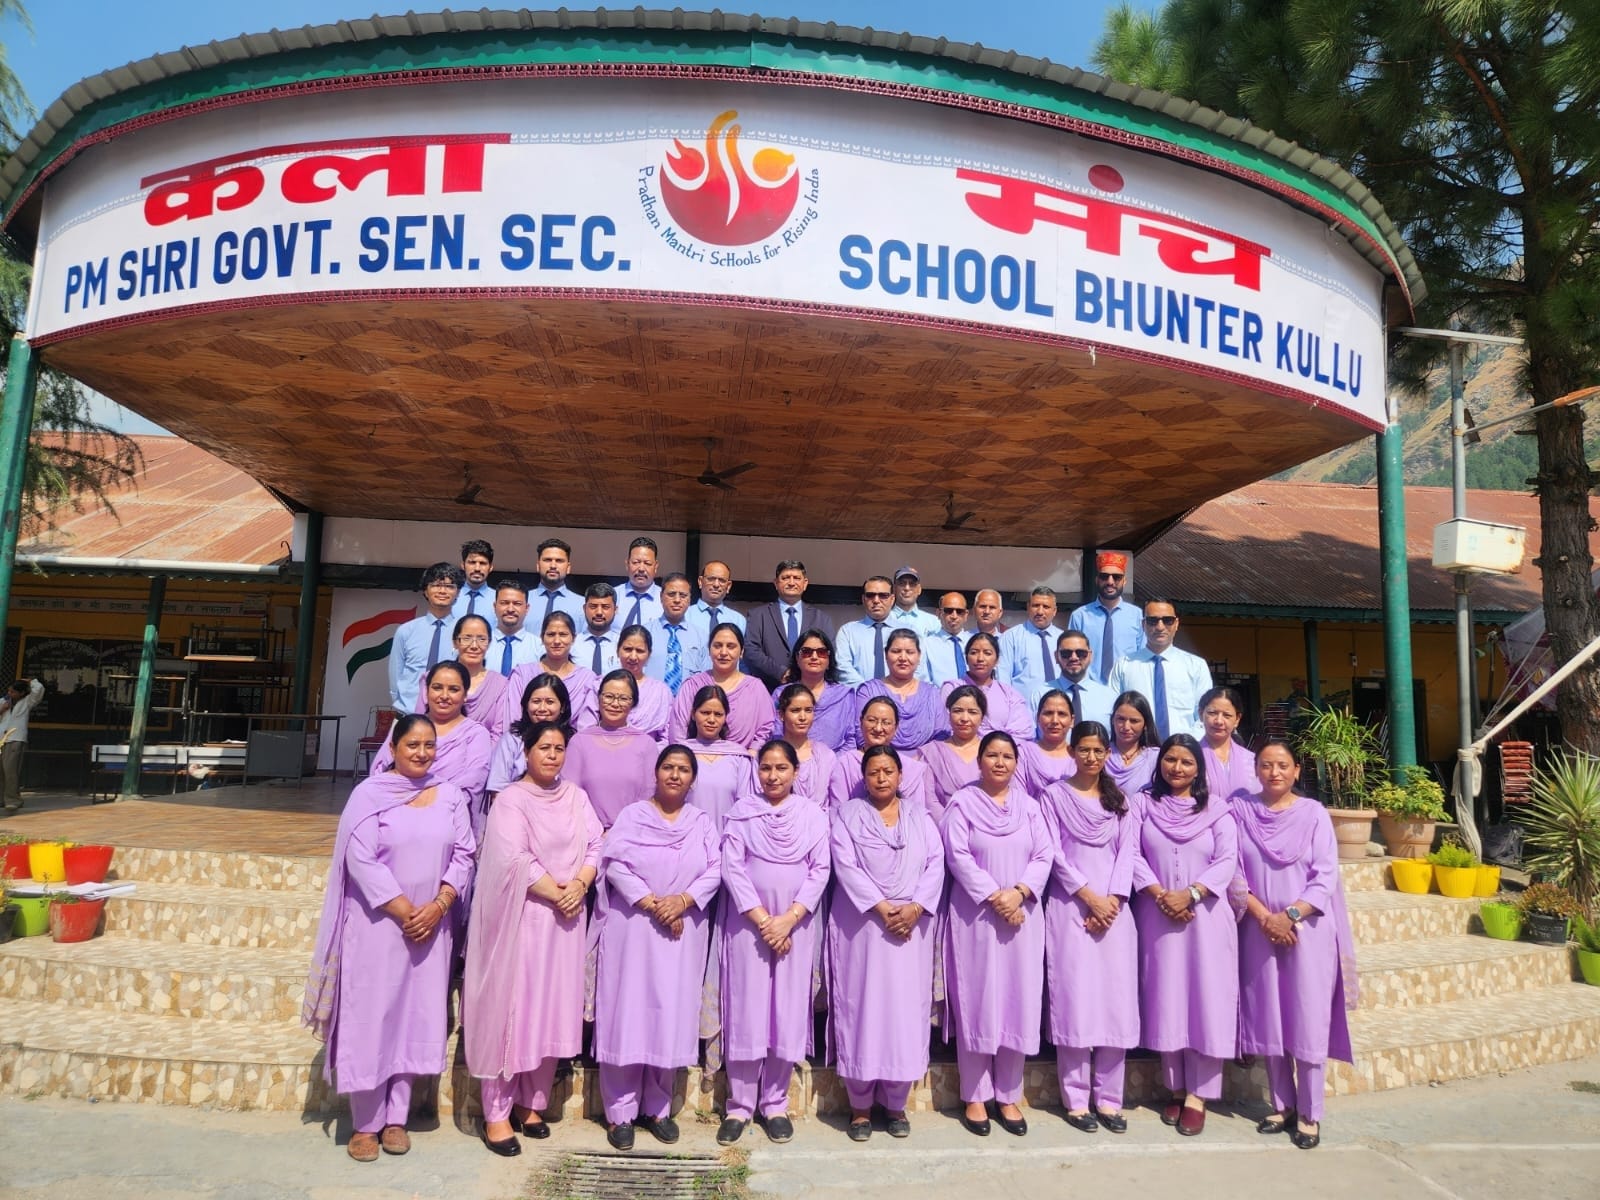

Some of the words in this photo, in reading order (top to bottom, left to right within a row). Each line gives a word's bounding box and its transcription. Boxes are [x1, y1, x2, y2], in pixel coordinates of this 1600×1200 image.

[140, 133, 511, 227] कला
[956, 164, 1272, 292] मंच
[638, 165, 661, 229] Pradhan
[660, 226, 705, 263] Mantri
[763, 244, 782, 260] for
[782, 207, 819, 248] Rising
[64, 256, 109, 313] PM
[117, 237, 200, 301] SHRI
[213, 219, 340, 284] GOVT.
[359, 214, 480, 273] SEN.
[501, 214, 631, 272] SEC.
[839, 234, 1054, 317] SCHOOL
[1075, 269, 1263, 363] BHUNTER
[1276, 322, 1362, 397] KULLU
